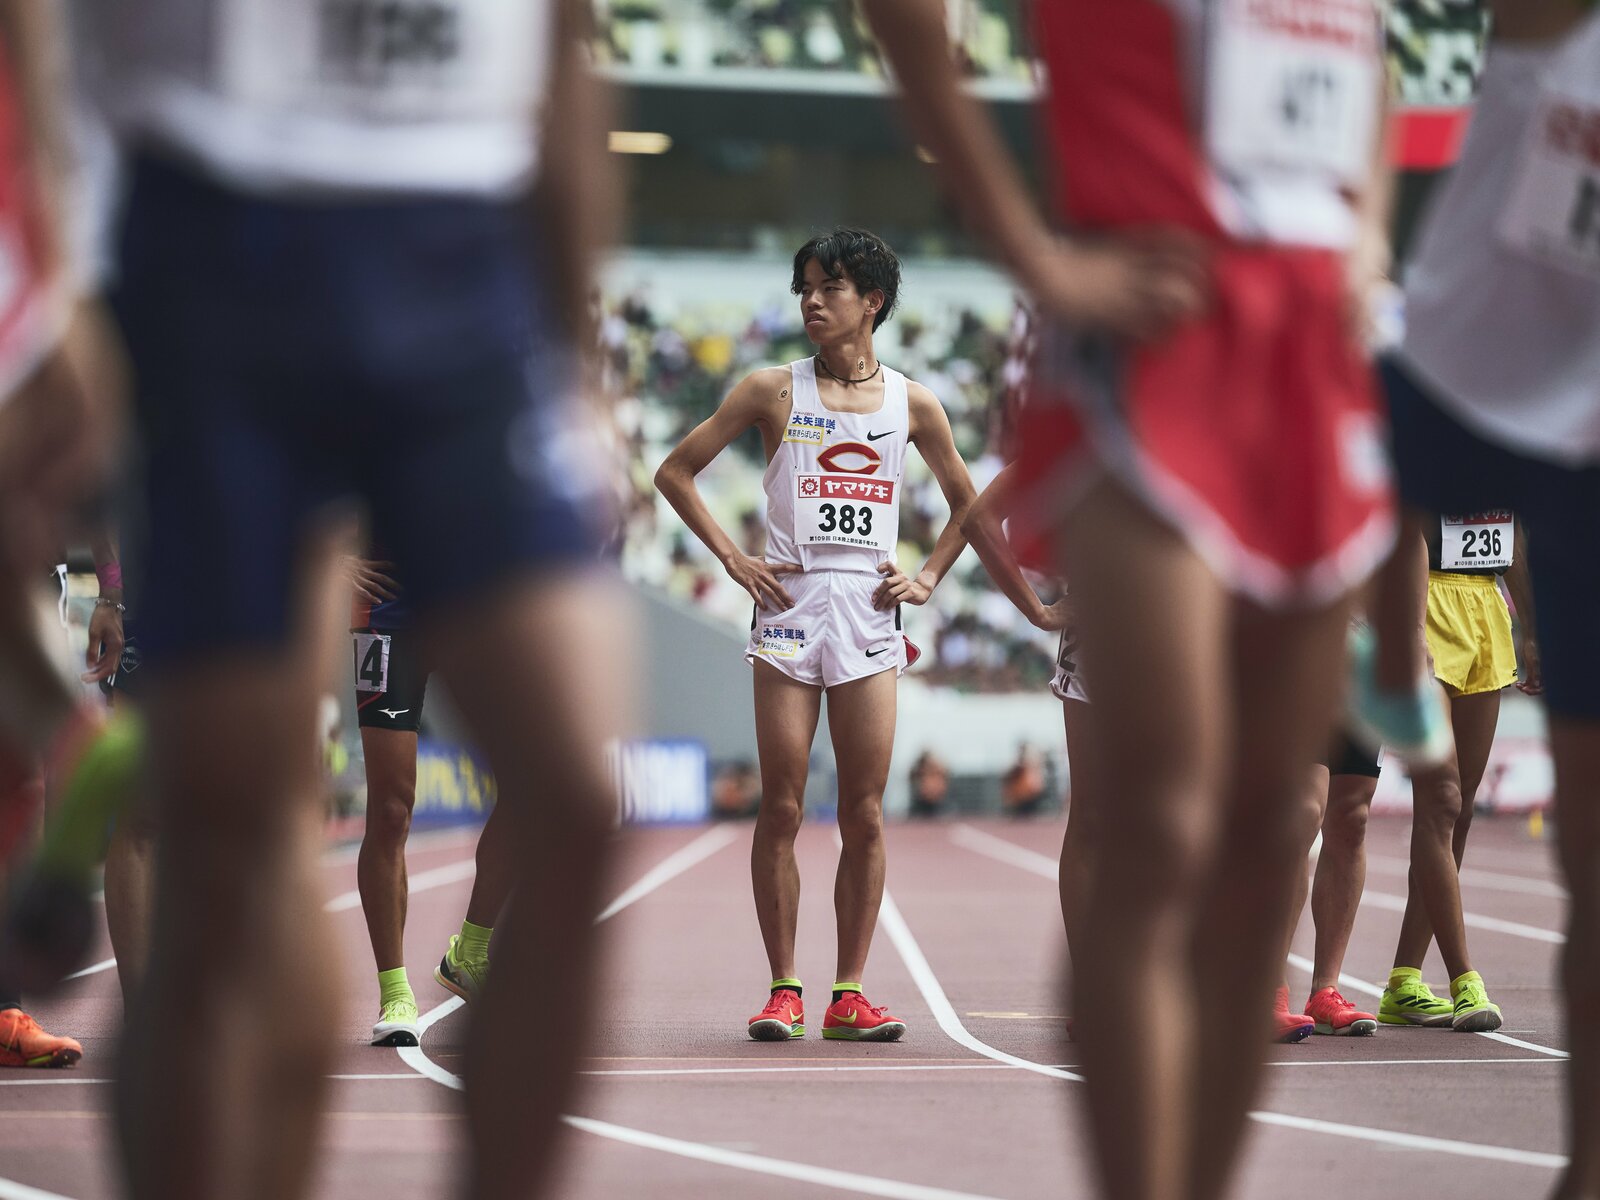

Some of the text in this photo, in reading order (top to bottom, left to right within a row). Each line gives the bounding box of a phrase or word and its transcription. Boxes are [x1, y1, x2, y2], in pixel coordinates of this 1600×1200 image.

[792, 415, 836, 430] 大矢運送
[824, 480, 889, 499] ヤマザキ
[818, 503, 873, 537] 383
[1462, 529, 1501, 557] 236
[763, 628, 806, 640] 大矢運送
